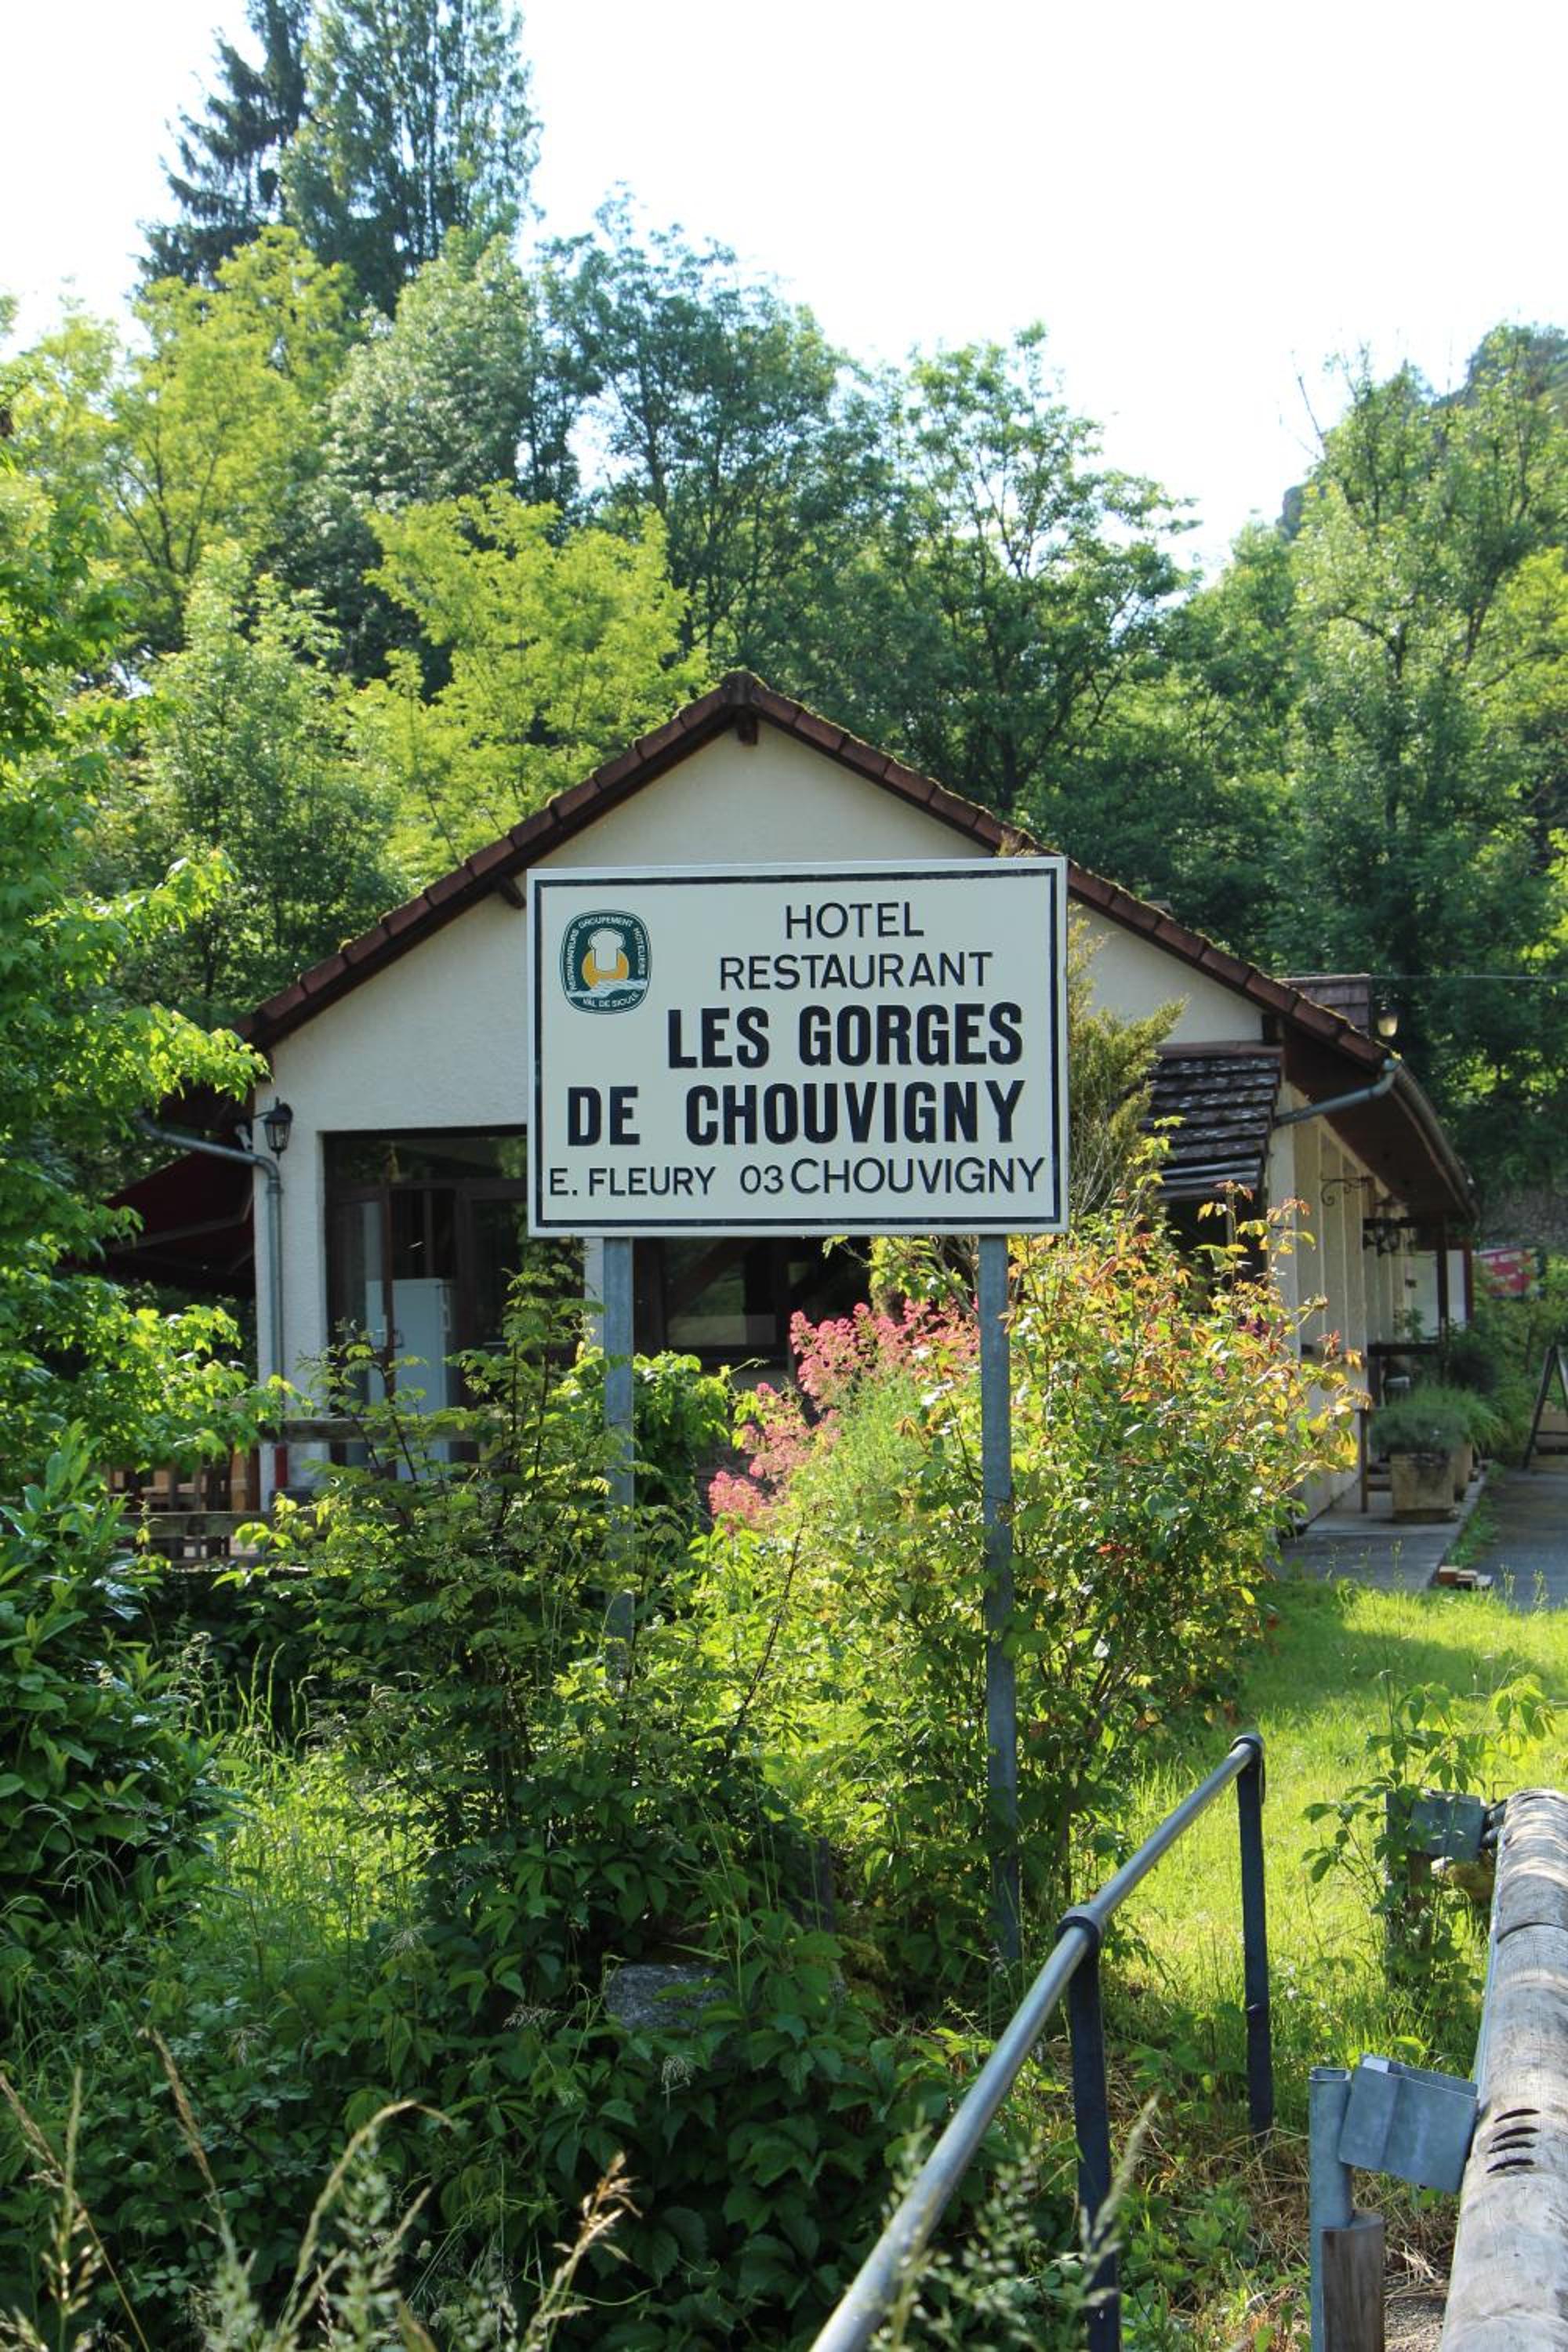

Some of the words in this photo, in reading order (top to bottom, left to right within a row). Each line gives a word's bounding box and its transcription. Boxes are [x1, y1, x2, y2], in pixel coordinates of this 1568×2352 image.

[579, 916, 633, 929] GROUPEMENT
[786, 901, 924, 939] HOTEL
[720, 951, 993, 991] RESTAURANT
[583, 997, 597, 1007] VAL
[667, 1006, 770, 1069] LES
[798, 1001, 1023, 1067] GORGES
[568, 1086, 641, 1147] DE
[686, 1080, 1025, 1146] CHOUVIGNY
[550, 1167, 579, 1196] E.
[589, 1166, 716, 1196] FLEURY
[790, 1156, 1045, 1194] CHOUVIGNY
